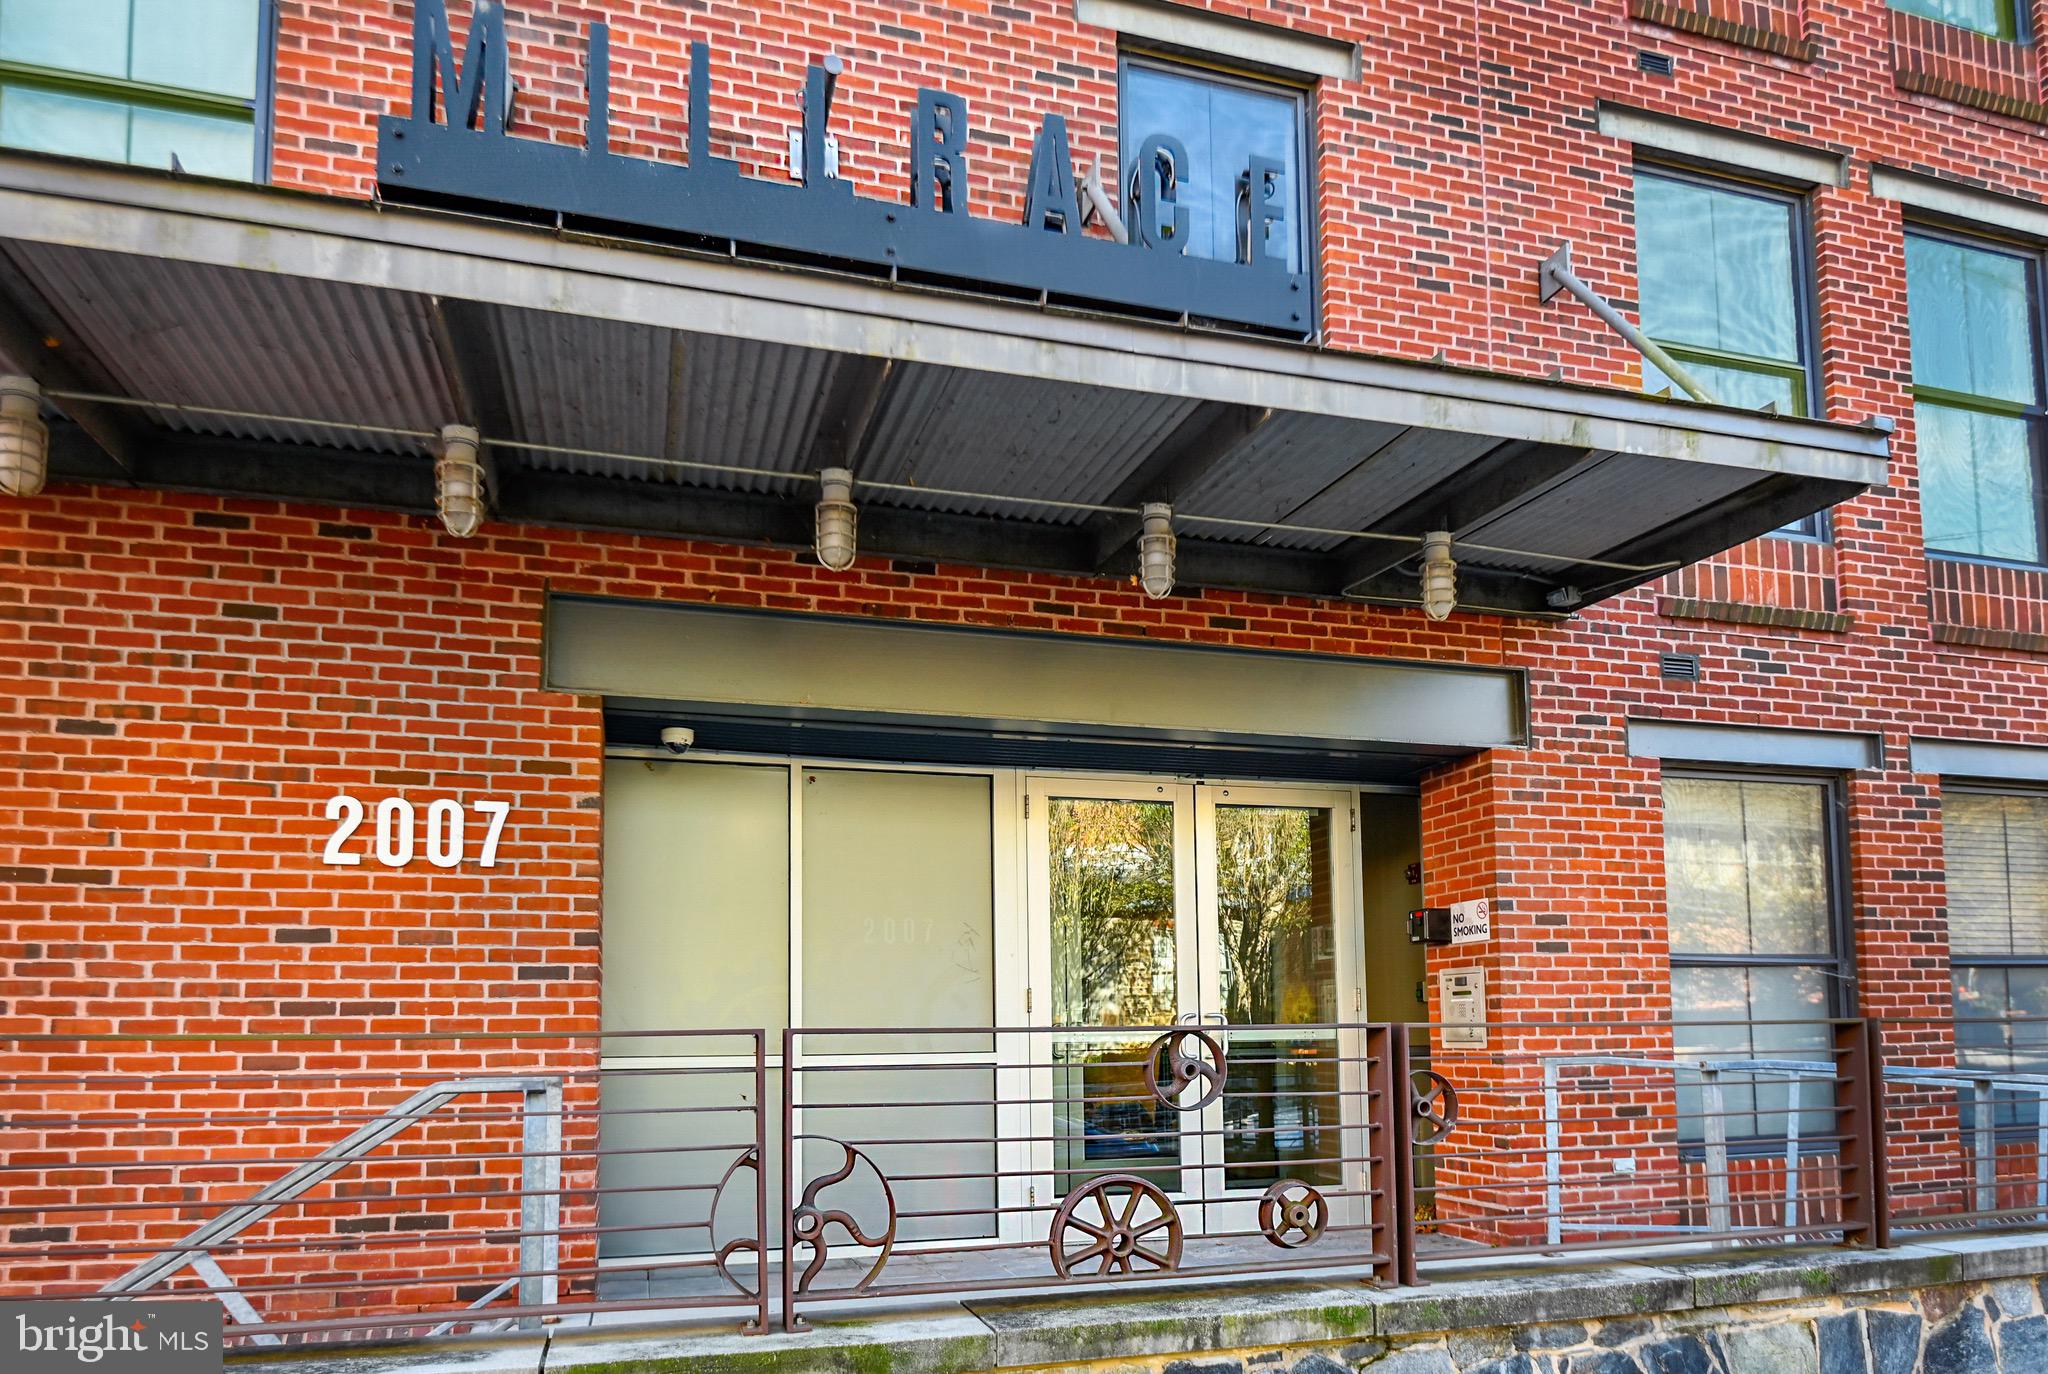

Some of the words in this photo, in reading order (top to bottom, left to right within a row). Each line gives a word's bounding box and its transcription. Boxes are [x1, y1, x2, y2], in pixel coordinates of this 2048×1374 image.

[411, 0, 1287, 276] MILLRACE
[323, 795, 510, 868] 2007
[864, 917, 934, 944] 2007
[1453, 913, 1465, 923] NO
[1453, 924, 1488, 937] SMOKING
